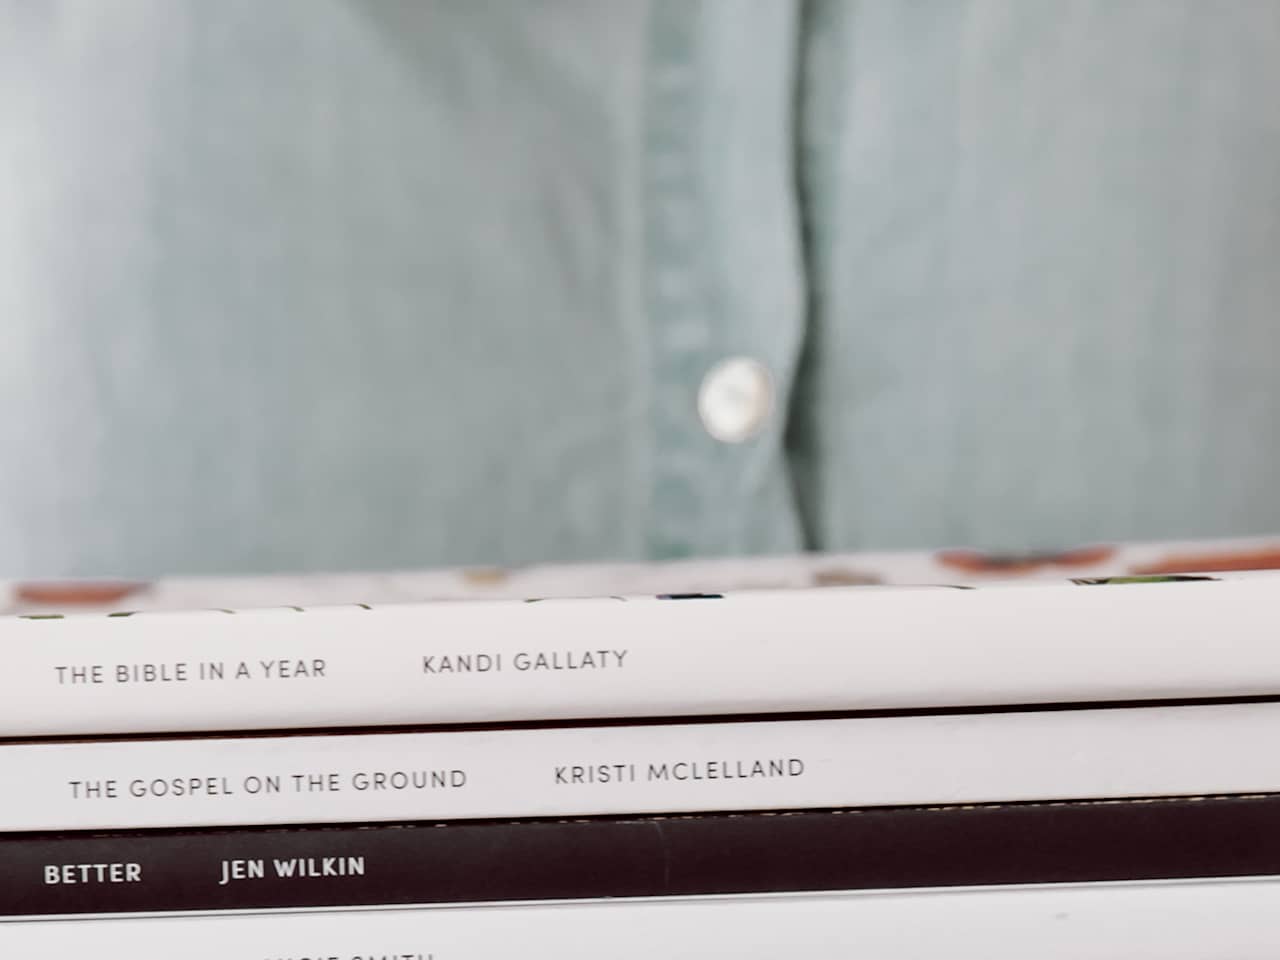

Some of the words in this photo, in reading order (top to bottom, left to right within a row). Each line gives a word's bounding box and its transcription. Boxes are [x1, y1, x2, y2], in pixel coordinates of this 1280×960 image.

[54, 665, 104, 684] THE
[116, 662, 188, 683] BIBLE
[200, 662, 224, 681] IN
[235, 661, 251, 679] A
[260, 658, 326, 679] YEAR
[423, 653, 501, 674] KANDI
[513, 649, 627, 672] GALLATY
[68, 780, 118, 799] THE
[129, 777, 233, 798] GOSPEL
[243, 775, 280, 795] ON
[291, 773, 341, 793] THE
[352, 769, 467, 791] GROUND
[555, 764, 635, 785] KRISTI
[647, 758, 804, 781] MCLELLAND
[44, 863, 141, 885] BETTER
[218, 859, 265, 885] JEN
[273, 856, 365, 878] WILKIN
